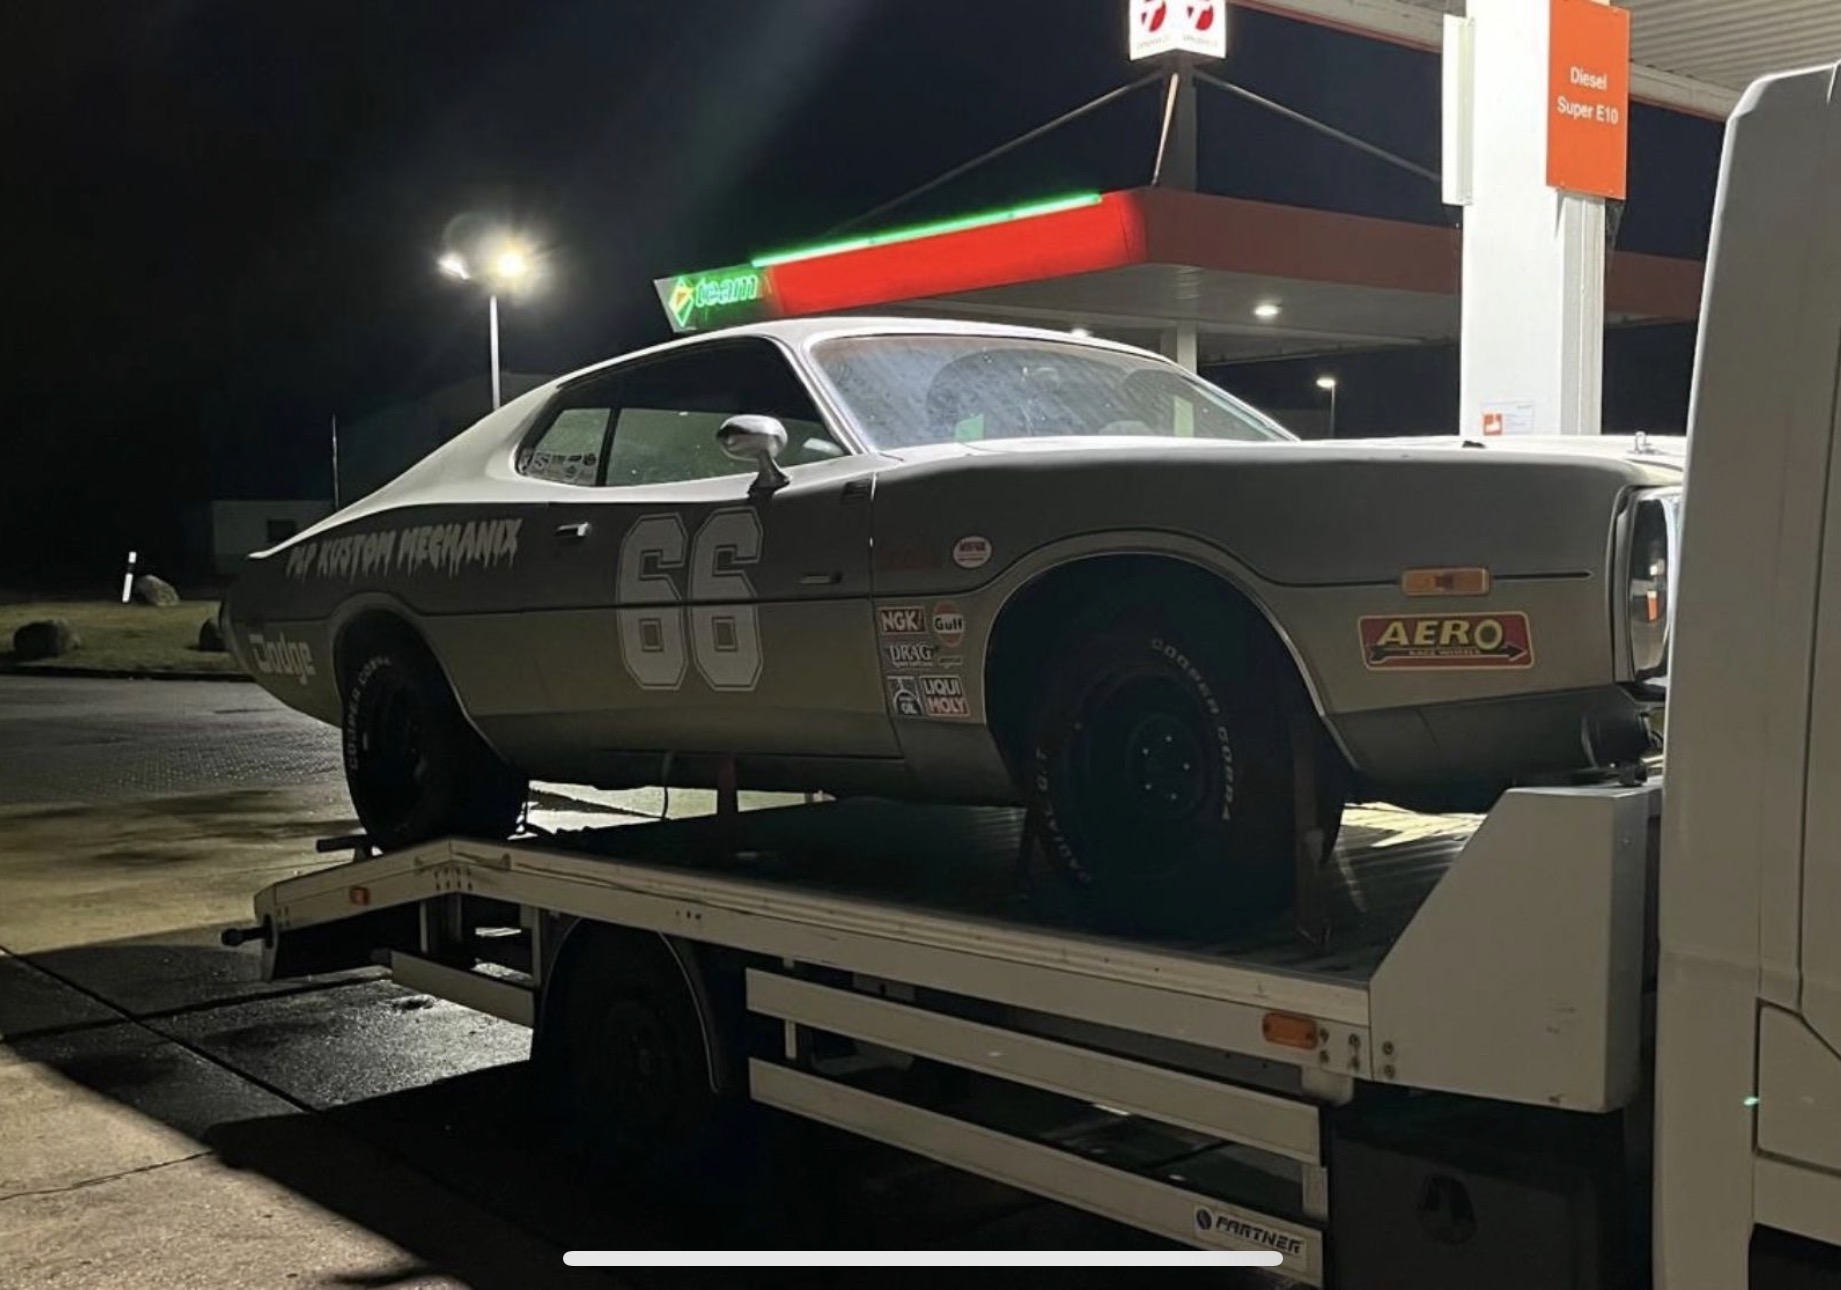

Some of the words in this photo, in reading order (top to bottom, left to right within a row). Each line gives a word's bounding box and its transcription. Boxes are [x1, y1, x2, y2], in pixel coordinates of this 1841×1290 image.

[1570, 66, 1607, 91] Diesel
[1557, 95, 1593, 120] Super
[1596, 103, 1619, 125] E10
[695, 274, 758, 307] team
[616, 506, 764, 691] 66
[881, 611, 917, 631] NGK
[934, 617, 963, 631] Gulf
[1376, 618, 1503, 650] AERO
[248, 631, 316, 686] Dodge
[923, 679, 960, 695] LIQUI
[926, 696, 965, 714] MOLY
[1215, 1216, 1304, 1254] PARTNER
